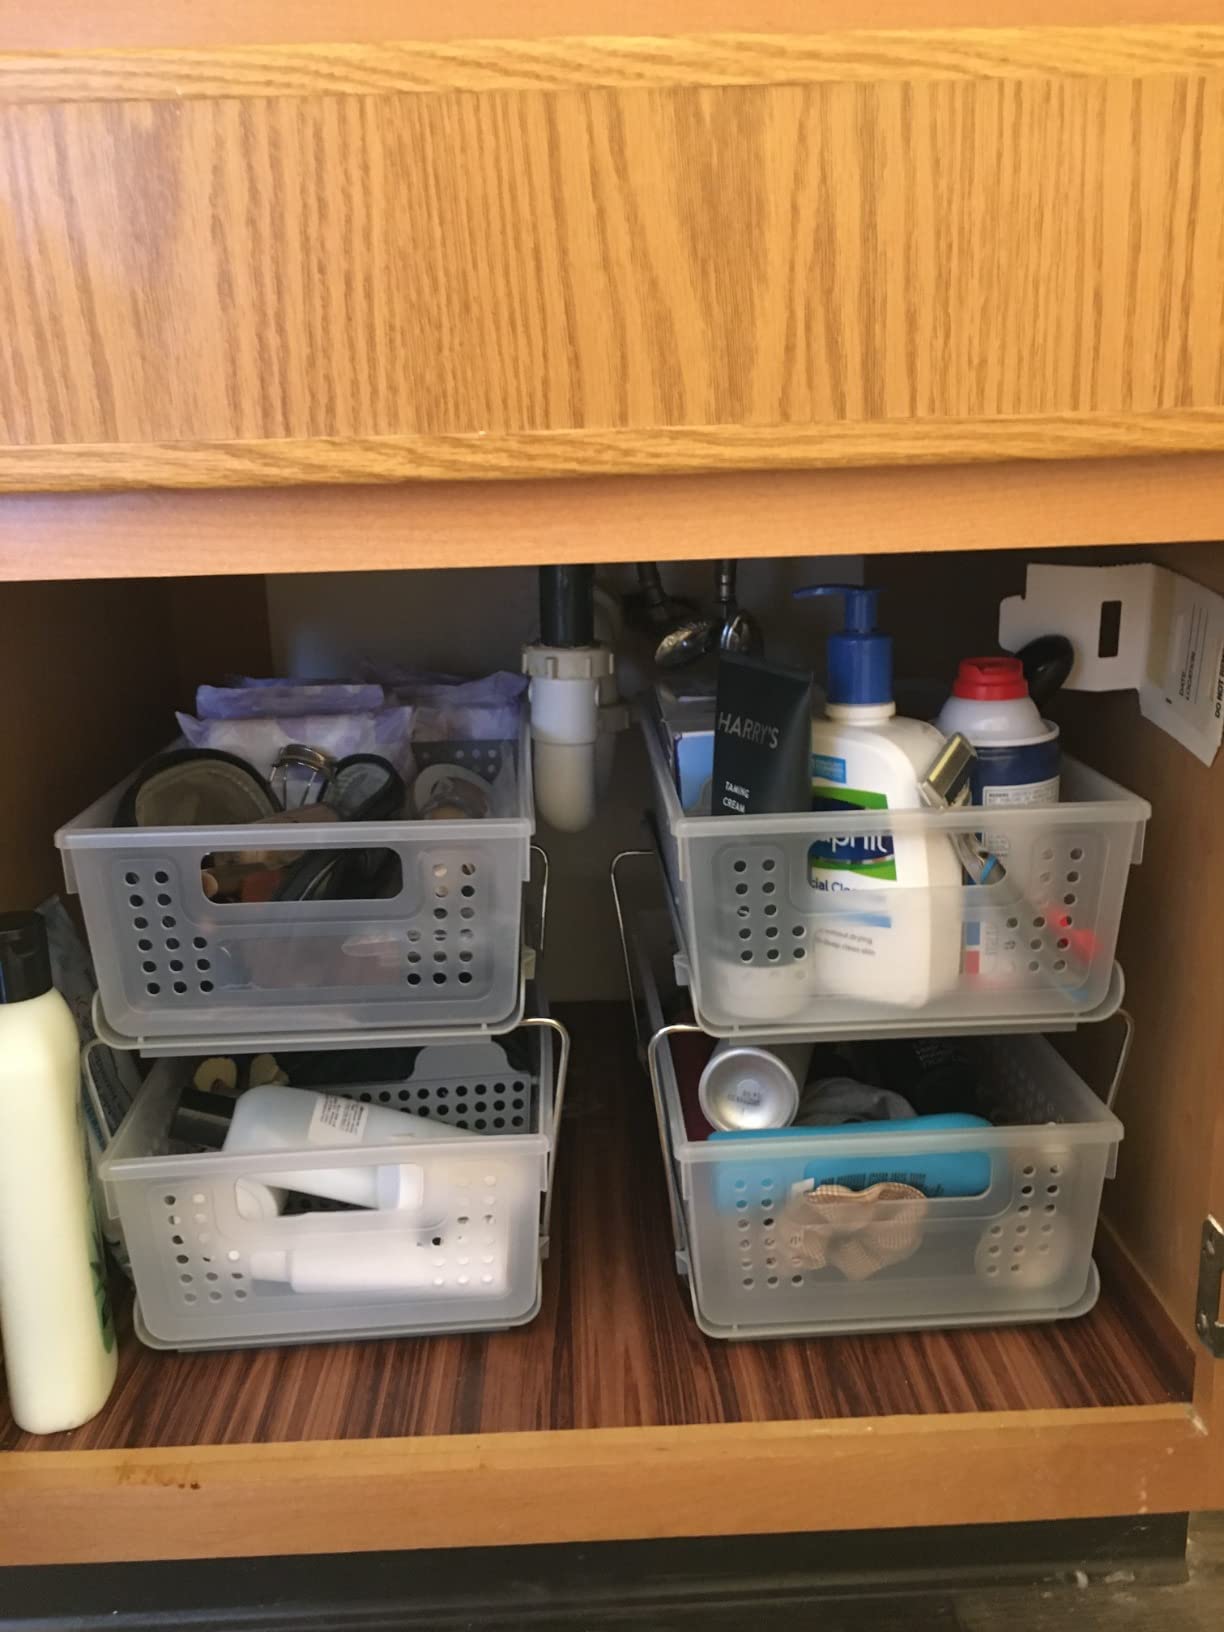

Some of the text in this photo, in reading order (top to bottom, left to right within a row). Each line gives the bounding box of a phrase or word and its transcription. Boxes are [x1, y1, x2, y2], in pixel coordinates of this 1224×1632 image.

[1179, 672, 1187, 696] DATE
[1186, 652, 1195, 700] LOCATION
[1215, 703, 1222, 718] DO
[719, 711, 779, 749] HARRY'S
[725, 781, 750, 799] TAMING
[722, 796, 745, 813] CREAM
